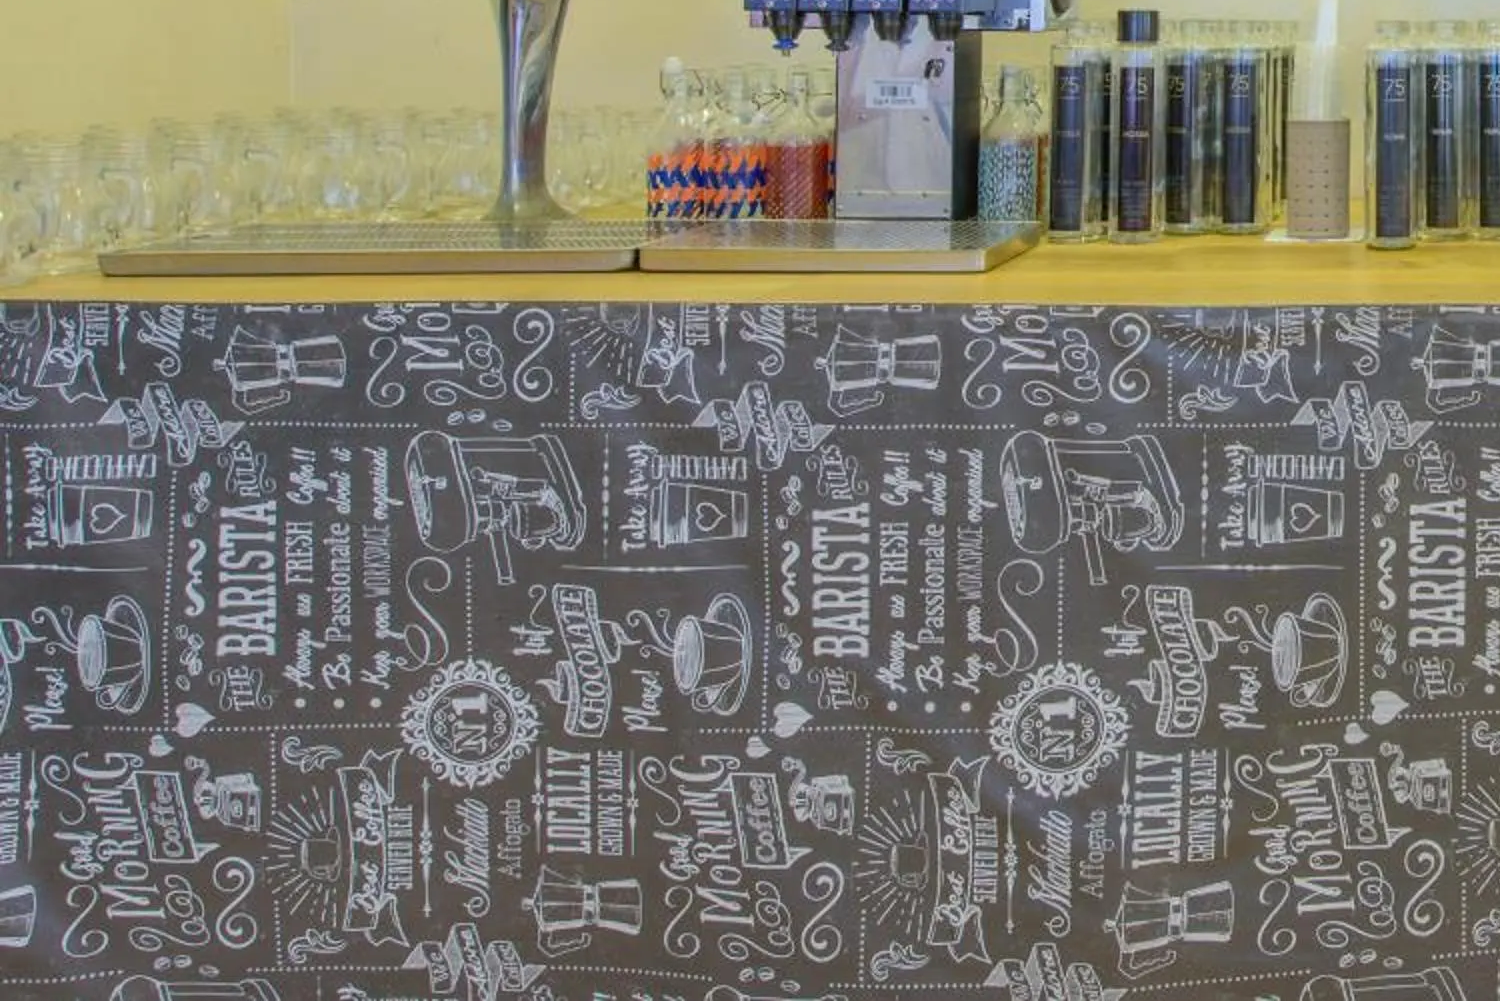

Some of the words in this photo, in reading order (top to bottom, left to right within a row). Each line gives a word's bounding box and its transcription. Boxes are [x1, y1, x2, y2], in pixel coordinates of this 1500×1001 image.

[23, 443, 53, 500] Away
[231, 441, 260, 498] RULES
[328, 448, 351, 462] it
[625, 441, 658, 501] Away
[821, 445, 851, 501] RULES
[922, 449, 947, 463] it
[958, 449, 999, 523] organised
[1223, 442, 1254, 498] Away
[1419, 441, 1449, 495] RULES
[325, 472, 351, 514] about
[921, 473, 947, 515] about
[24, 503, 49, 550] Take
[285, 521, 313, 585] FRESH
[621, 503, 649, 552] Take
[879, 522, 908, 587] FRESH
[1219, 501, 1247, 550] Take
[216, 500, 277, 658] BARISTA
[324, 524, 351, 642] Passionate
[810, 504, 871, 659] BARISTA
[918, 525, 945, 644] Passionate
[957, 526, 983, 601] WORKSPACE
[1406, 496, 1467, 651] BARISTA
[966, 606, 995, 643] your
[227, 666, 256, 710] THE
[282, 628, 326, 690] Always
[322, 653, 351, 690] Be
[559, 590, 606, 729] CHOCOLATE
[825, 666, 851, 709] THE
[875, 630, 919, 693] Always
[915, 655, 943, 692] Be
[1151, 591, 1202, 727] CHOCOLATE
[1420, 657, 1448, 699] THE
[24, 666, 73, 731] Please!
[623, 669, 668, 733] Please!
[1219, 664, 1266, 730] Please!
[598, 750, 623, 789] MADE
[150, 775, 185, 857] Coffee
[352, 780, 383, 845] Coffee
[546, 747, 591, 855] LOCALLY
[598, 806, 623, 856] GROWN
[744, 776, 781, 862] Coffee
[942, 787, 970, 853] Coffee
[1132, 750, 1181, 868] LOCALLY
[1266, 742, 1360, 911] MORNING
[1345, 762, 1380, 842] Coffee
[53, 831, 104, 881] Good
[72, 752, 166, 919] MORNING
[498, 798, 531, 878] Affogato
[654, 833, 699, 882] Good
[669, 754, 759, 923] MORNING
[1080, 810, 1116, 898] Affogato
[1247, 824, 1298, 875] Good
[351, 861, 379, 913] Best
[938, 871, 965, 925] Best
